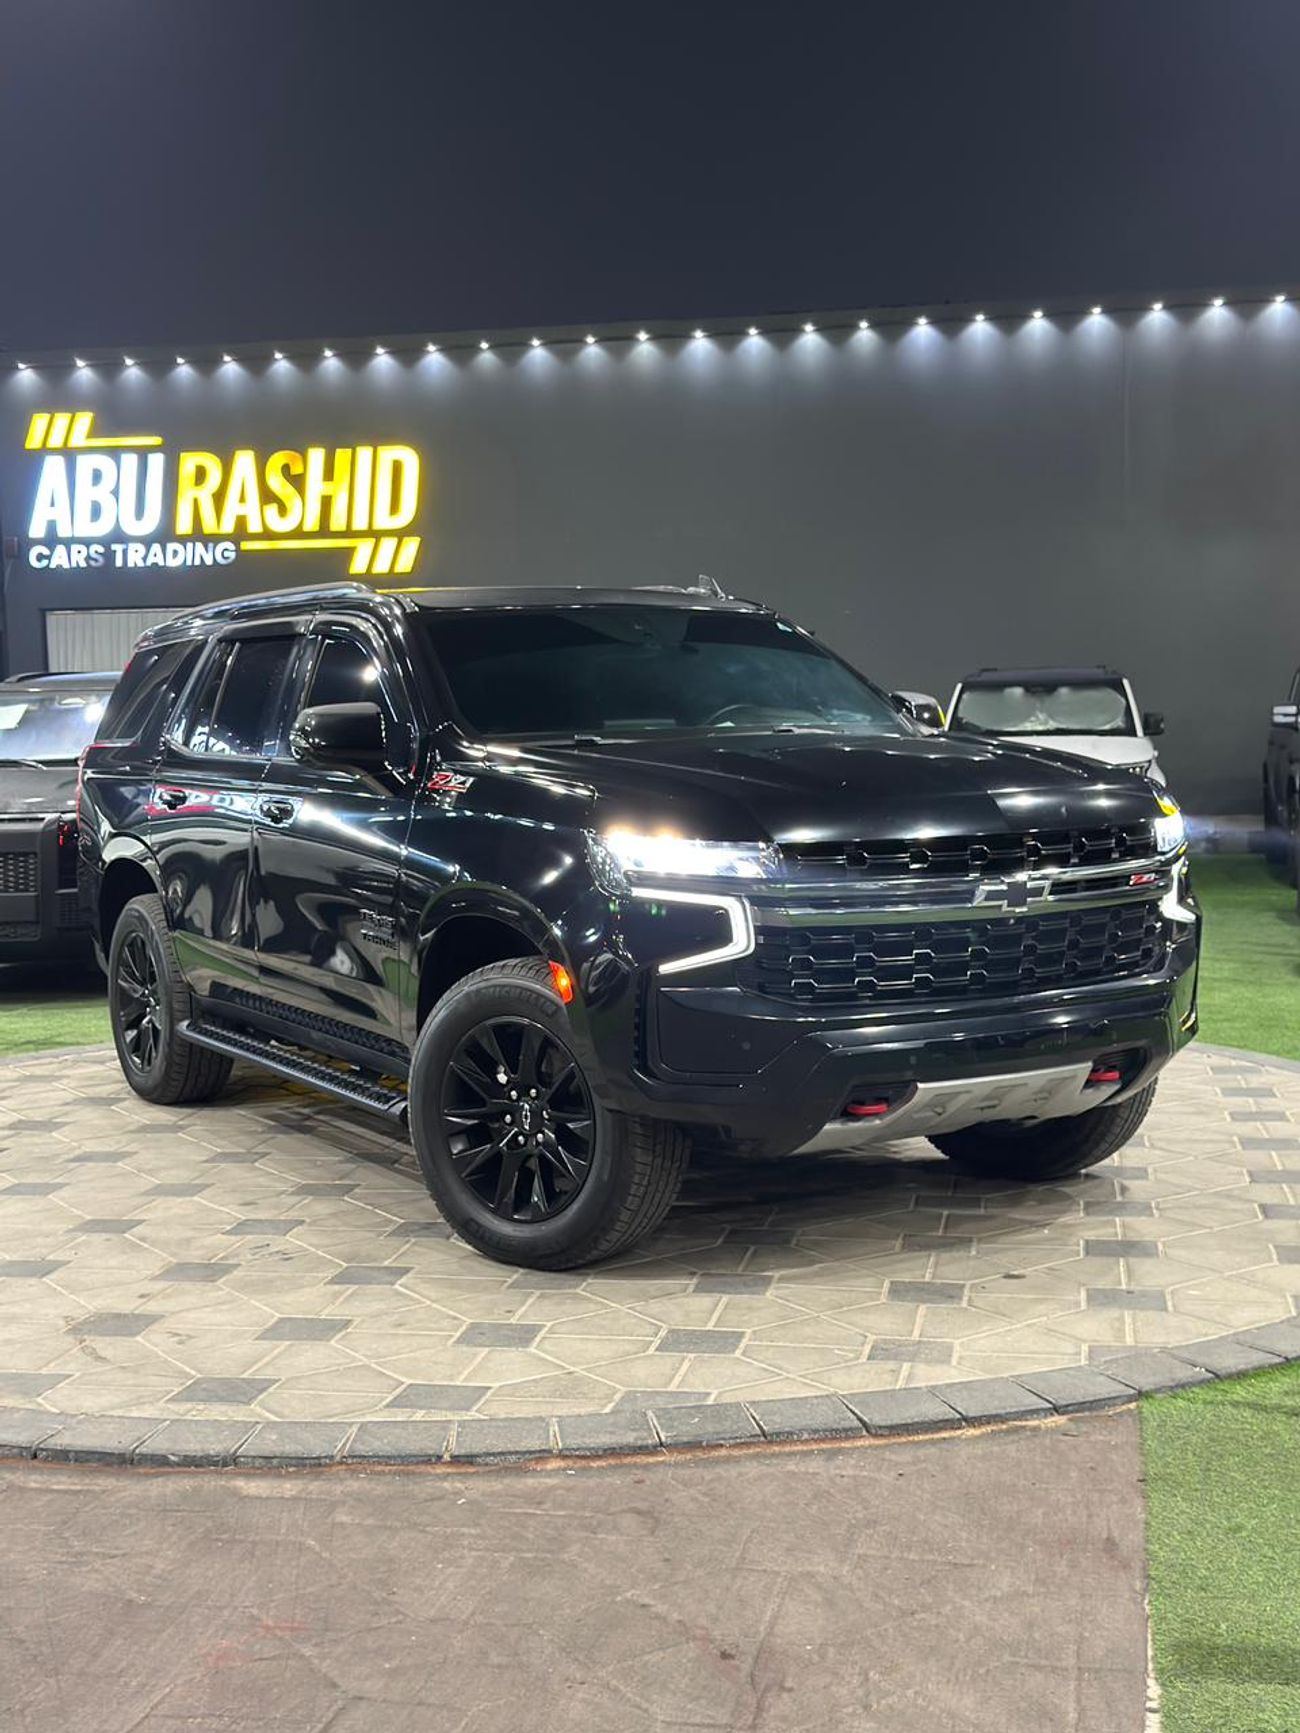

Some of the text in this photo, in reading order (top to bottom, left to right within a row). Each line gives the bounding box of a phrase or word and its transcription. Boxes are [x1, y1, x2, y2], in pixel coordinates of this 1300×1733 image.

[28, 445, 420, 538] ABU RASHID
[28, 541, 236, 569] CARS TRADING
[428, 771, 475, 793] Z71
